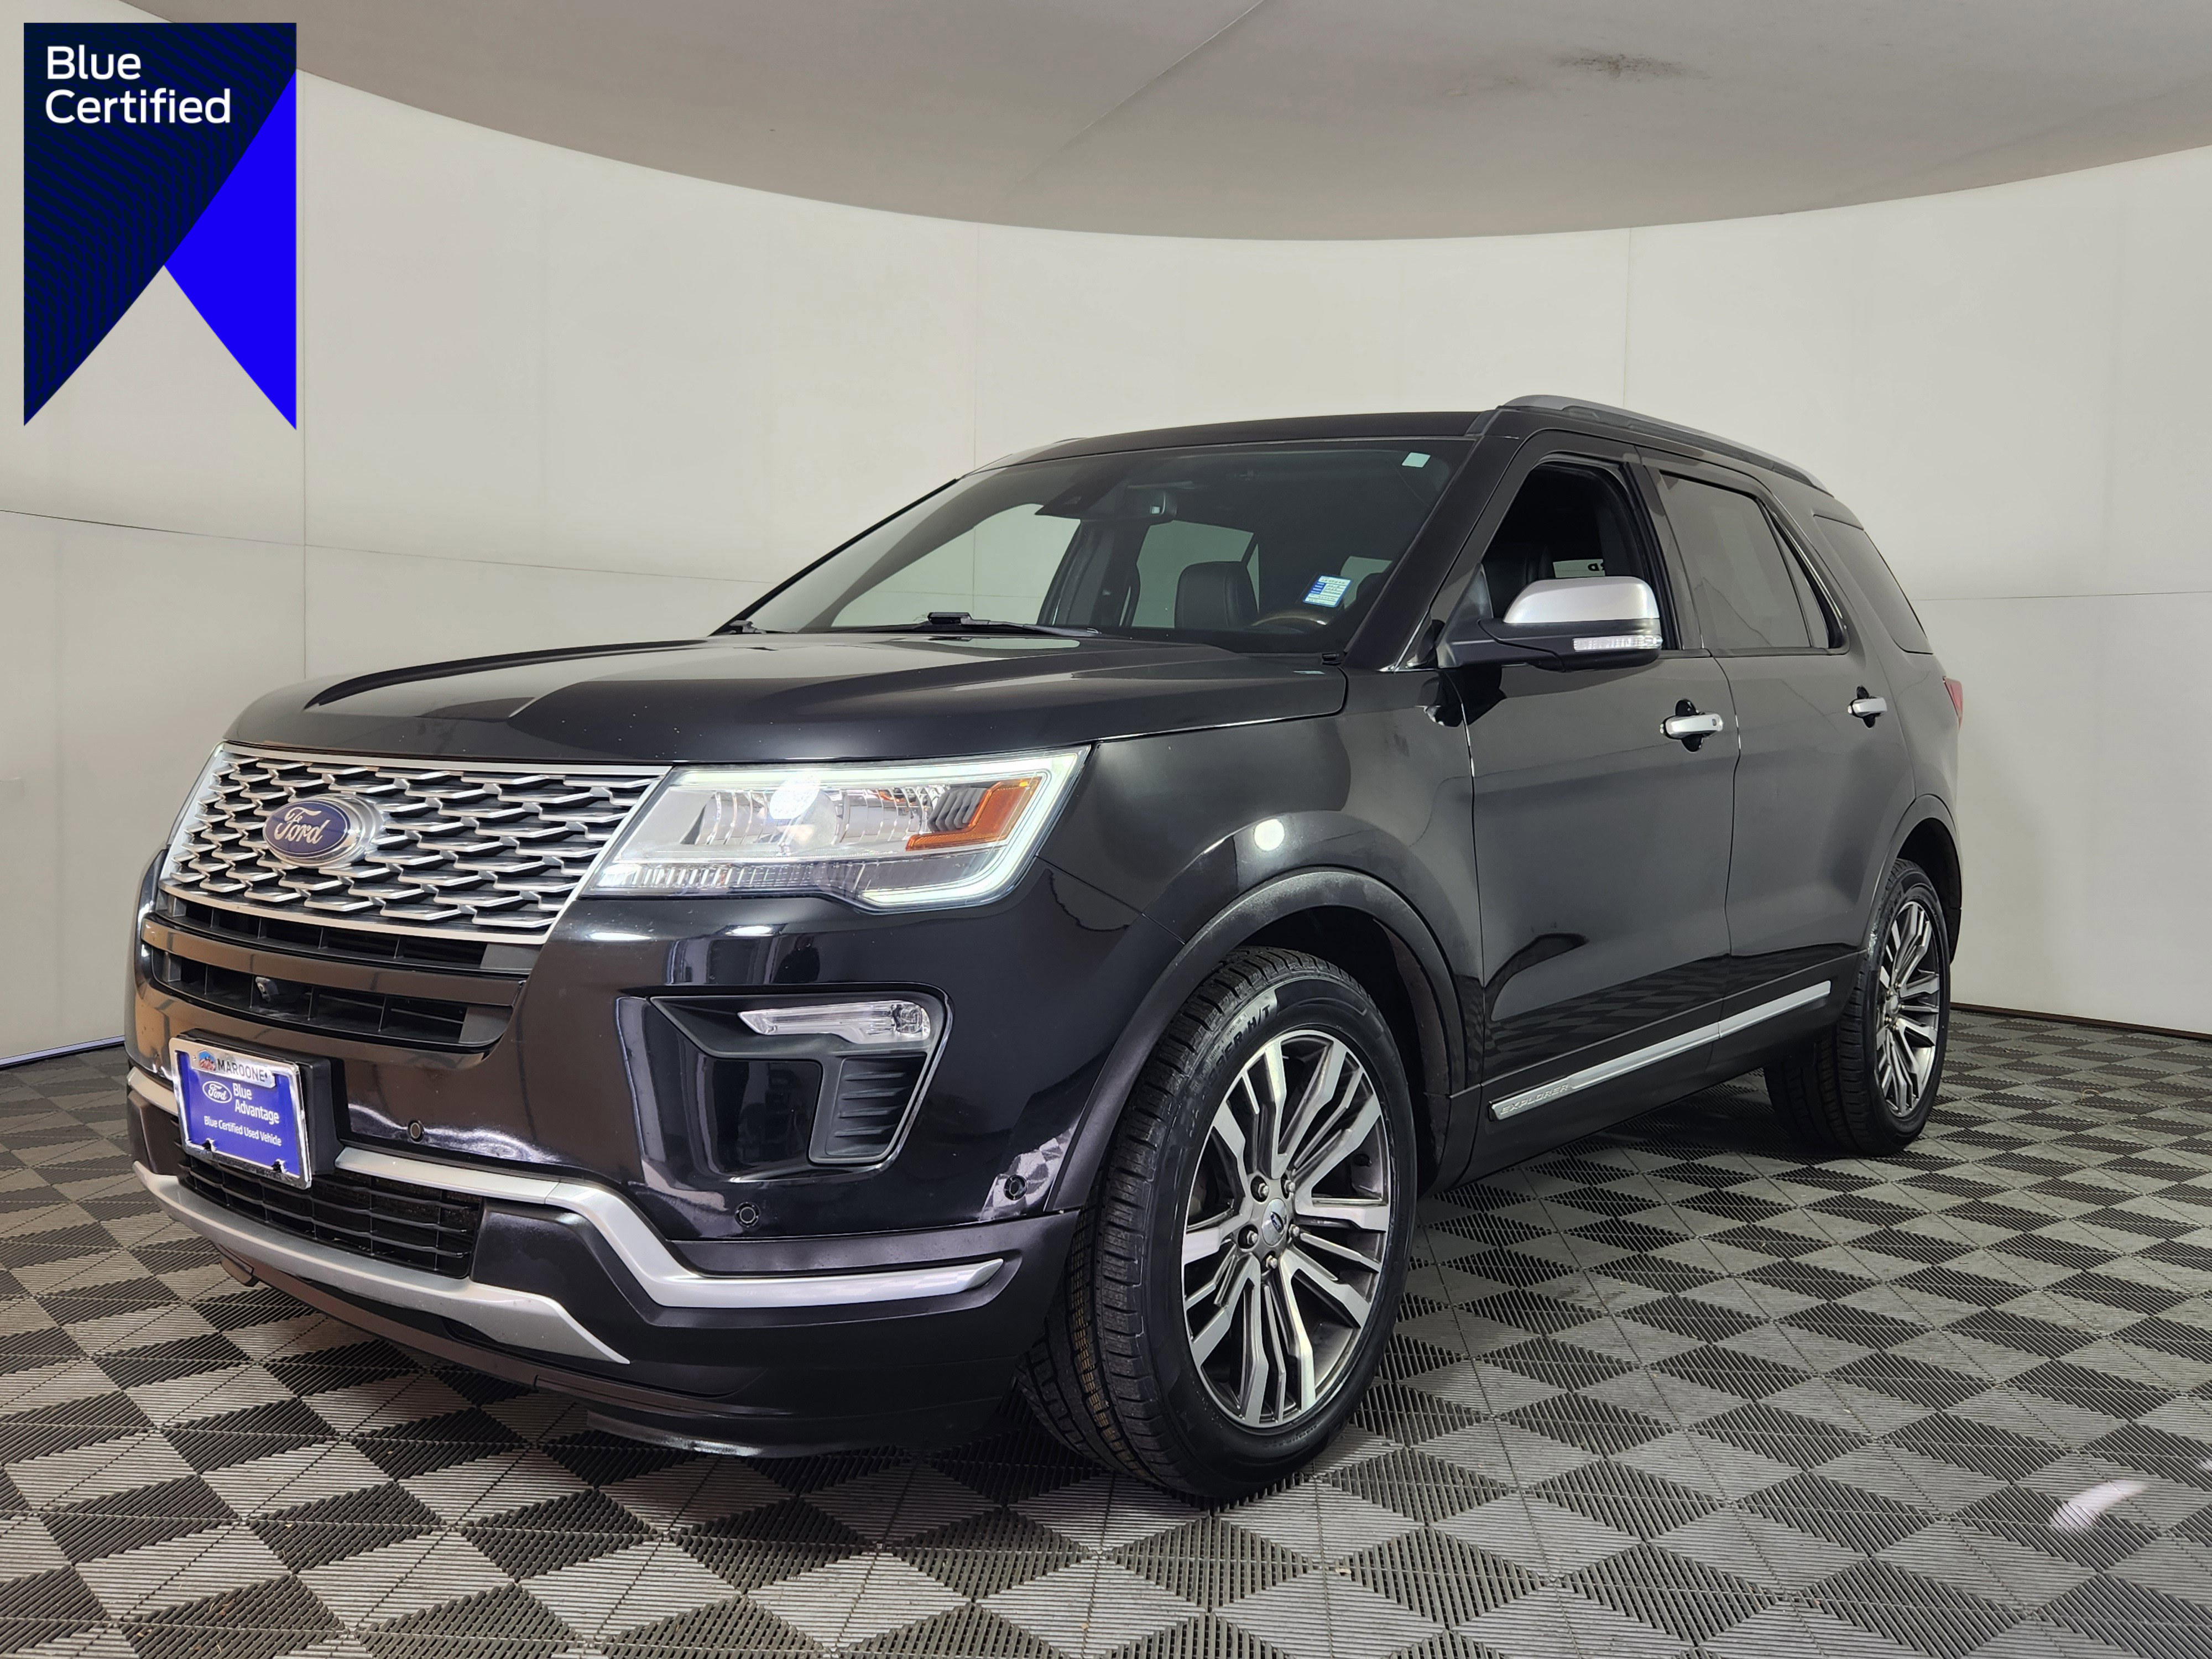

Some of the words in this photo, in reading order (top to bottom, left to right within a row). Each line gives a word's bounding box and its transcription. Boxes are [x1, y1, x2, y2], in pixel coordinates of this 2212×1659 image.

[274, 807, 331, 844] Ford
[207, 1083, 227, 1100] Ford
[233, 1083, 253, 1100] Blue
[1500, 1083, 1569, 1115] EXPLORER
[234, 1099, 280, 1125] Advantage
[204, 1115, 218, 1128] Blue
[218, 1120, 243, 1135] Certified
[244, 1126, 259, 1140] Used
[259, 1131, 282, 1147] Vehicle
